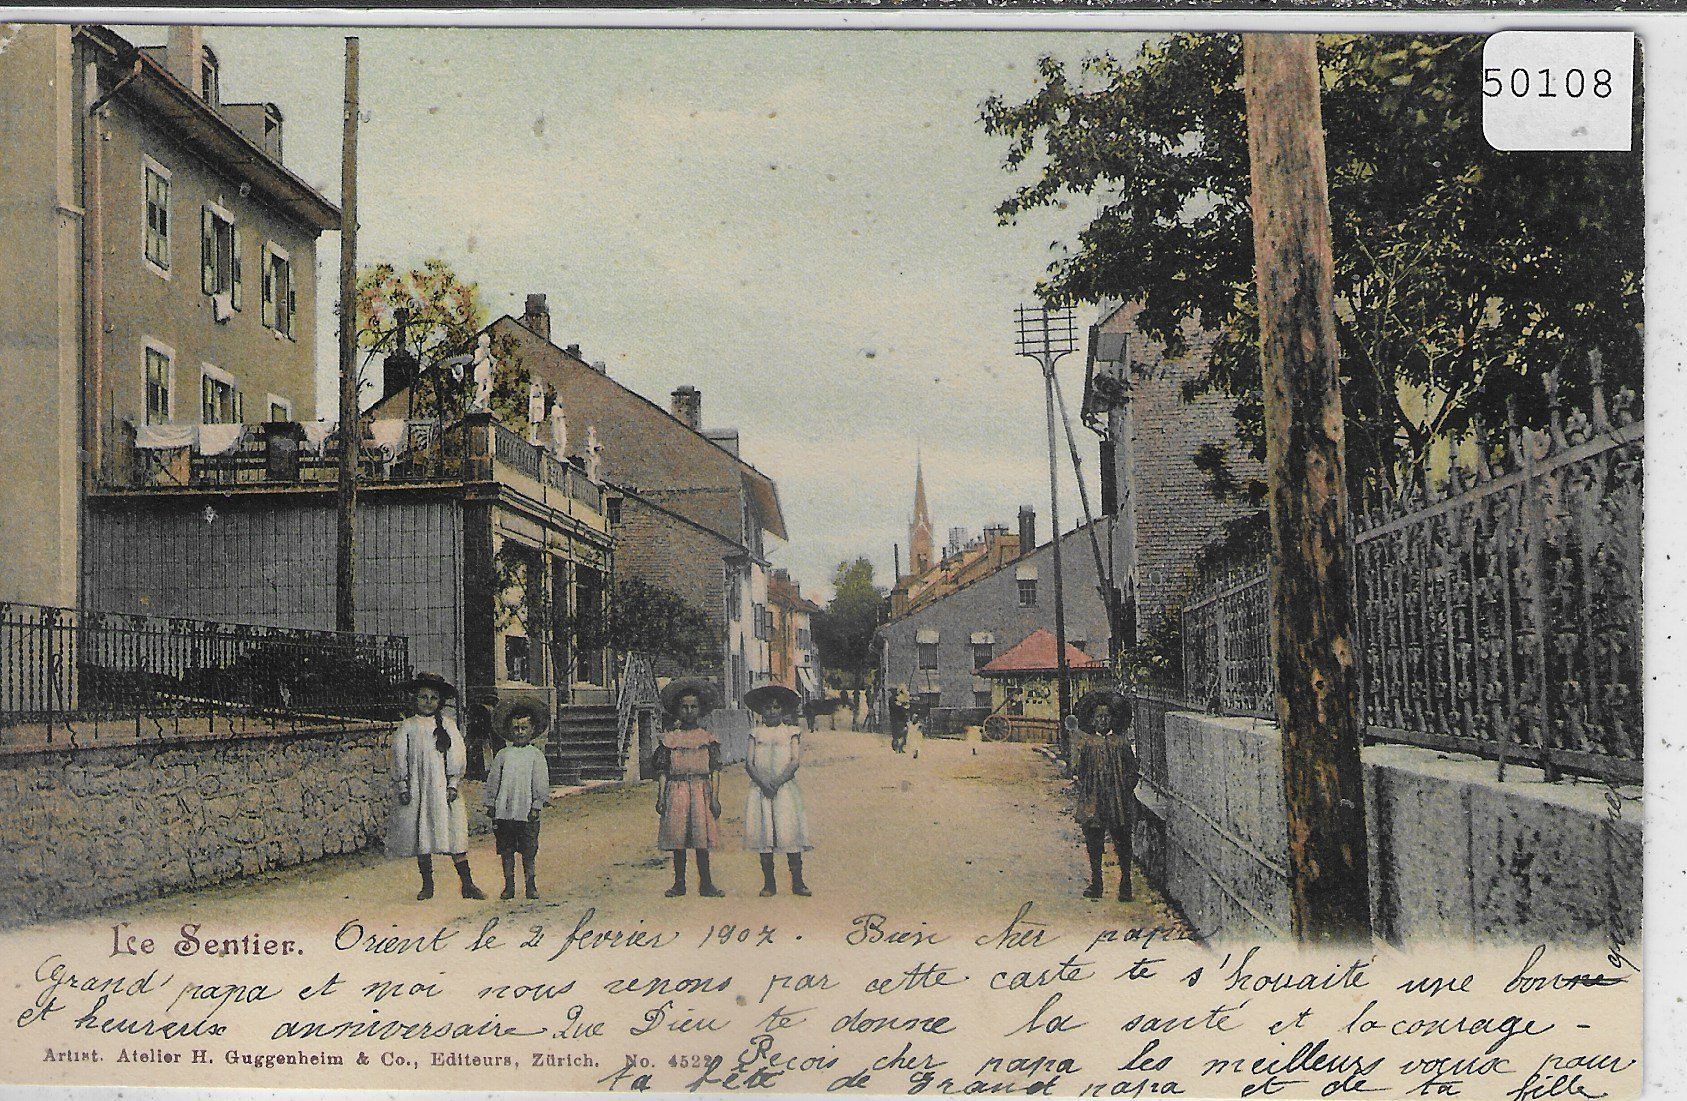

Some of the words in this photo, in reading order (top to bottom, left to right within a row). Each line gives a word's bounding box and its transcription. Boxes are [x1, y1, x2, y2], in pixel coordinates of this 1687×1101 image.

[1483, 68, 1612, 98] 50108
[109, 921, 155, 958] Le
[173, 923, 304, 958] Sentier.
[334, 918, 460, 954] Orient
[464, 916, 506, 952] le
[166, 981, 283, 1019] papa
[298, 972, 346, 1000] et
[361, 971, 444, 1003] moi
[477, 980, 577, 1002] nous
[758, 973, 840, 1004] par
[1113, 957, 1168, 981] te
[1396, 974, 1474, 998] une
[16, 996, 66, 1028] et
[74, 994, 227, 1040] heureux
[629, 1000, 731, 1037] Dieu
[755, 1004, 818, 1033] te
[830, 1007, 957, 1034] donne
[1003, 992, 1089, 1037] la
[1268, 1007, 1313, 1036] et
[117, 1049, 181, 1064] Atelier
[192, 1050, 213, 1064] H.
[225, 1050, 343, 1068] Guggenheim
[356, 1051, 370, 1066] &
[381, 1052, 418, 1069] Co.,
[431, 1052, 519, 1069] Editeurs,
[532, 1052, 600, 1068] Zürich.
[625, 1054, 655, 1068] No.
[873, 1042, 948, 1070] cher
[974, 1056, 1083, 1078] papa
[1118, 1038, 1174, 1071] les
[1240, 1075, 1311, 1098] et
[1321, 1074, 1393, 1098] de
[1405, 1074, 1465, 1096] ta
